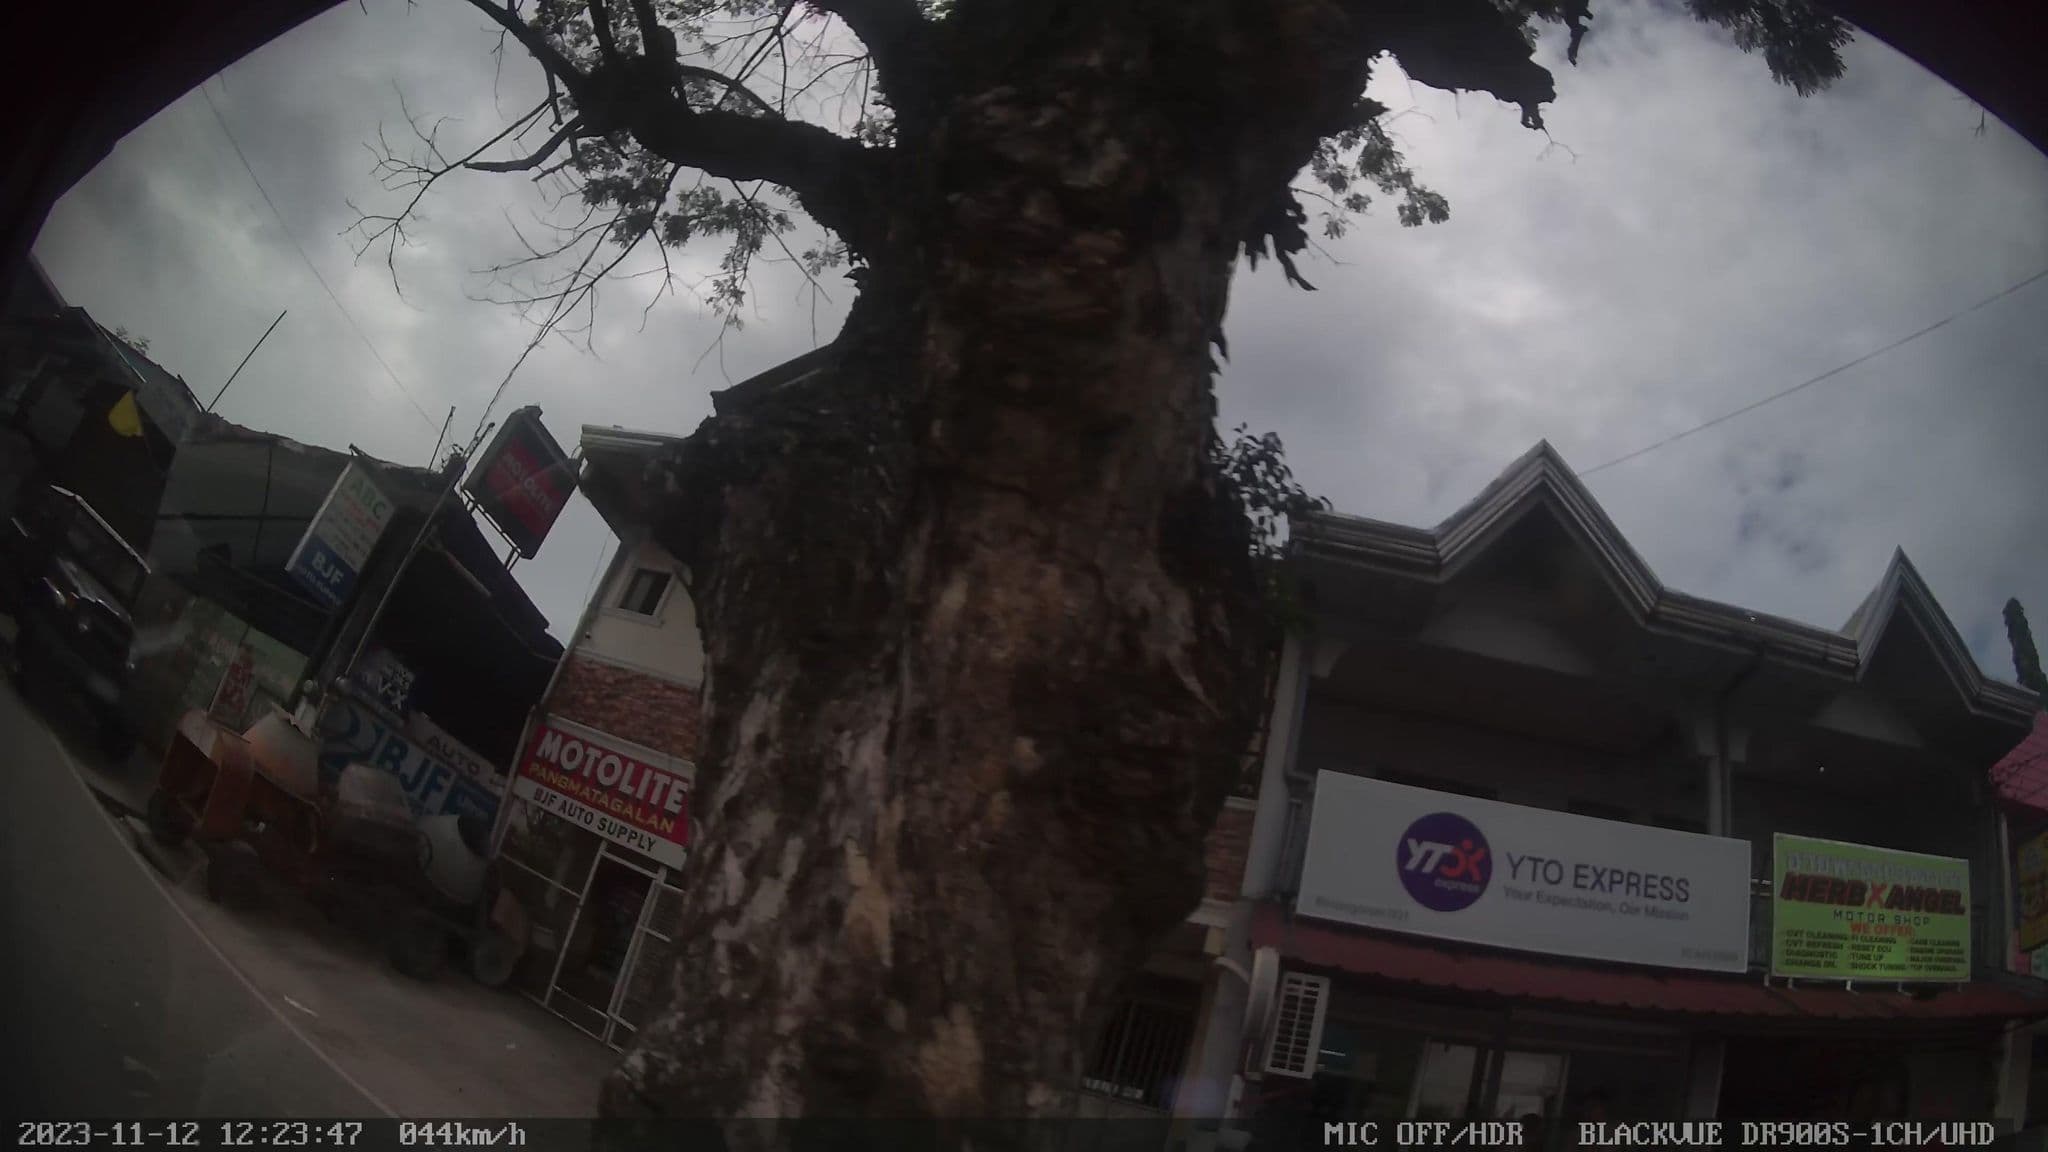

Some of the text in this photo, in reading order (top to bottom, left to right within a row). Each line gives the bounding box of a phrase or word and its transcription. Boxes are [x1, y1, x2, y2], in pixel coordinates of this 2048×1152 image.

[312, 550, 345, 587] BJF
[377, 737, 453, 803] BJF
[428, 735, 481, 777] AUTO
[535, 730, 689, 815] MOTOLITE
[534, 787, 657, 853] BJF AUTO SUPPLY
[1505, 851, 1691, 903] YTO EXPRESS
[1780, 872, 1966, 915] HERB X ANGEL
[1504, 885, 1533, 902] Your
[1618, 901, 1641, 916] Our
[1643, 905, 1690, 922] Mission
[1833, 910, 1931, 926] MOTOR SHOP
[1850, 922, 1870, 936] WE
